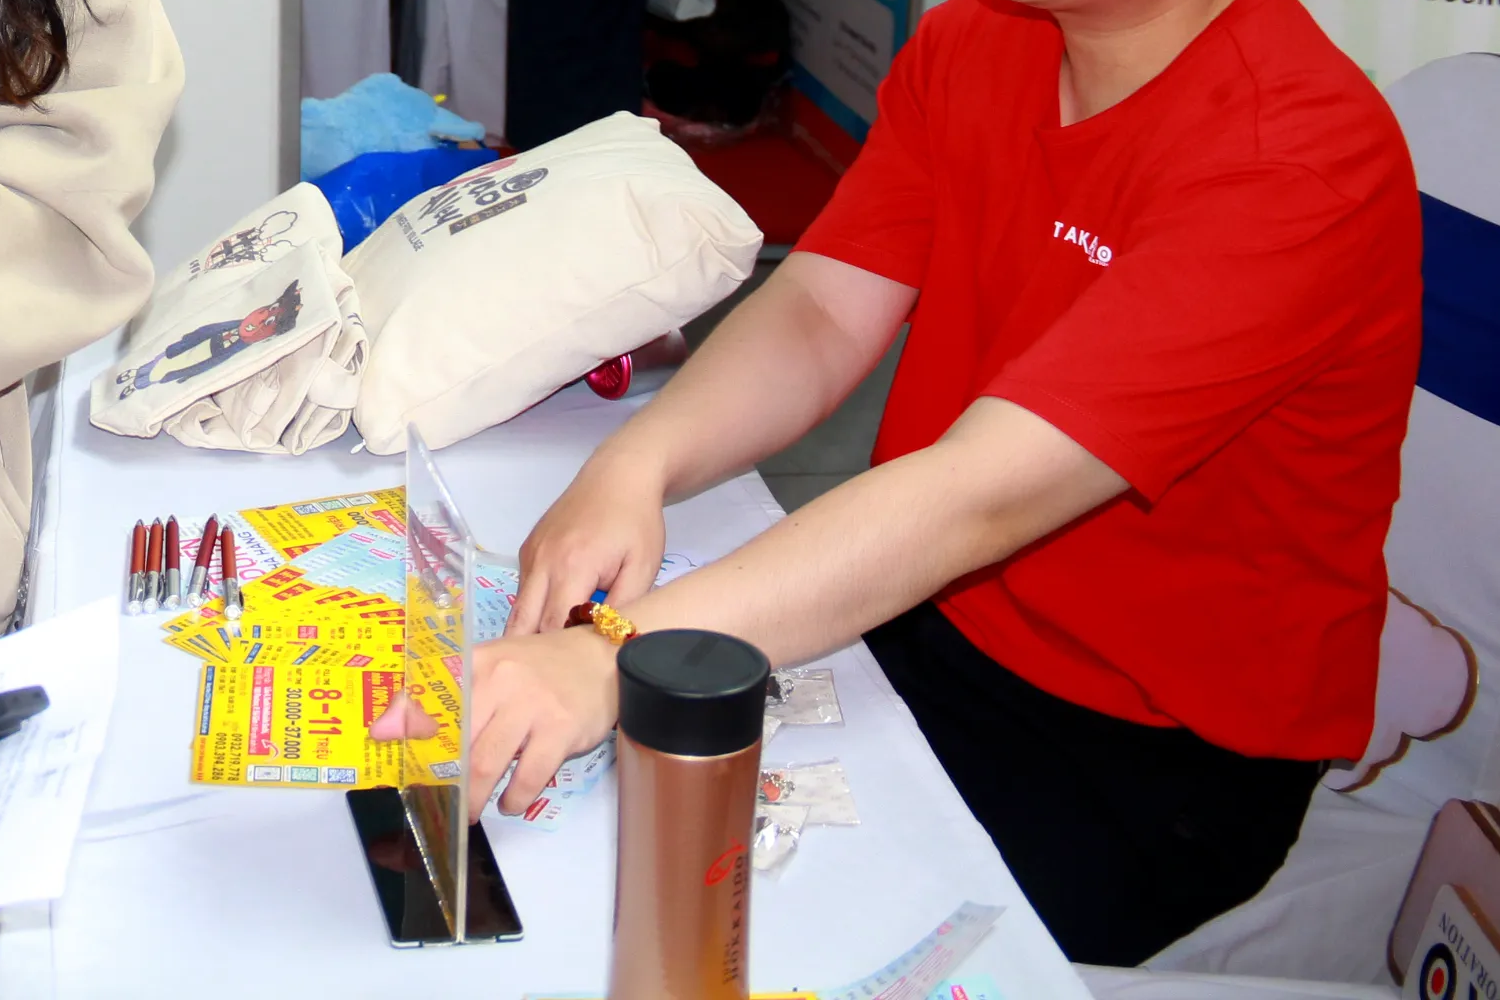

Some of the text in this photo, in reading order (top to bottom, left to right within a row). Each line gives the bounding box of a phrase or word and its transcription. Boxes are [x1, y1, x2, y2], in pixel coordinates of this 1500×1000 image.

[283, 687, 302, 760] 30.000-37.000
[370, 685, 388, 705] 100%
[212, 732, 227, 780] 0903.394.286
[228, 733, 242, 781] 0932.719.778
[731, 855, 743, 980] HOKKAIDO
[1438, 911, 1497, 1000] ORATION
